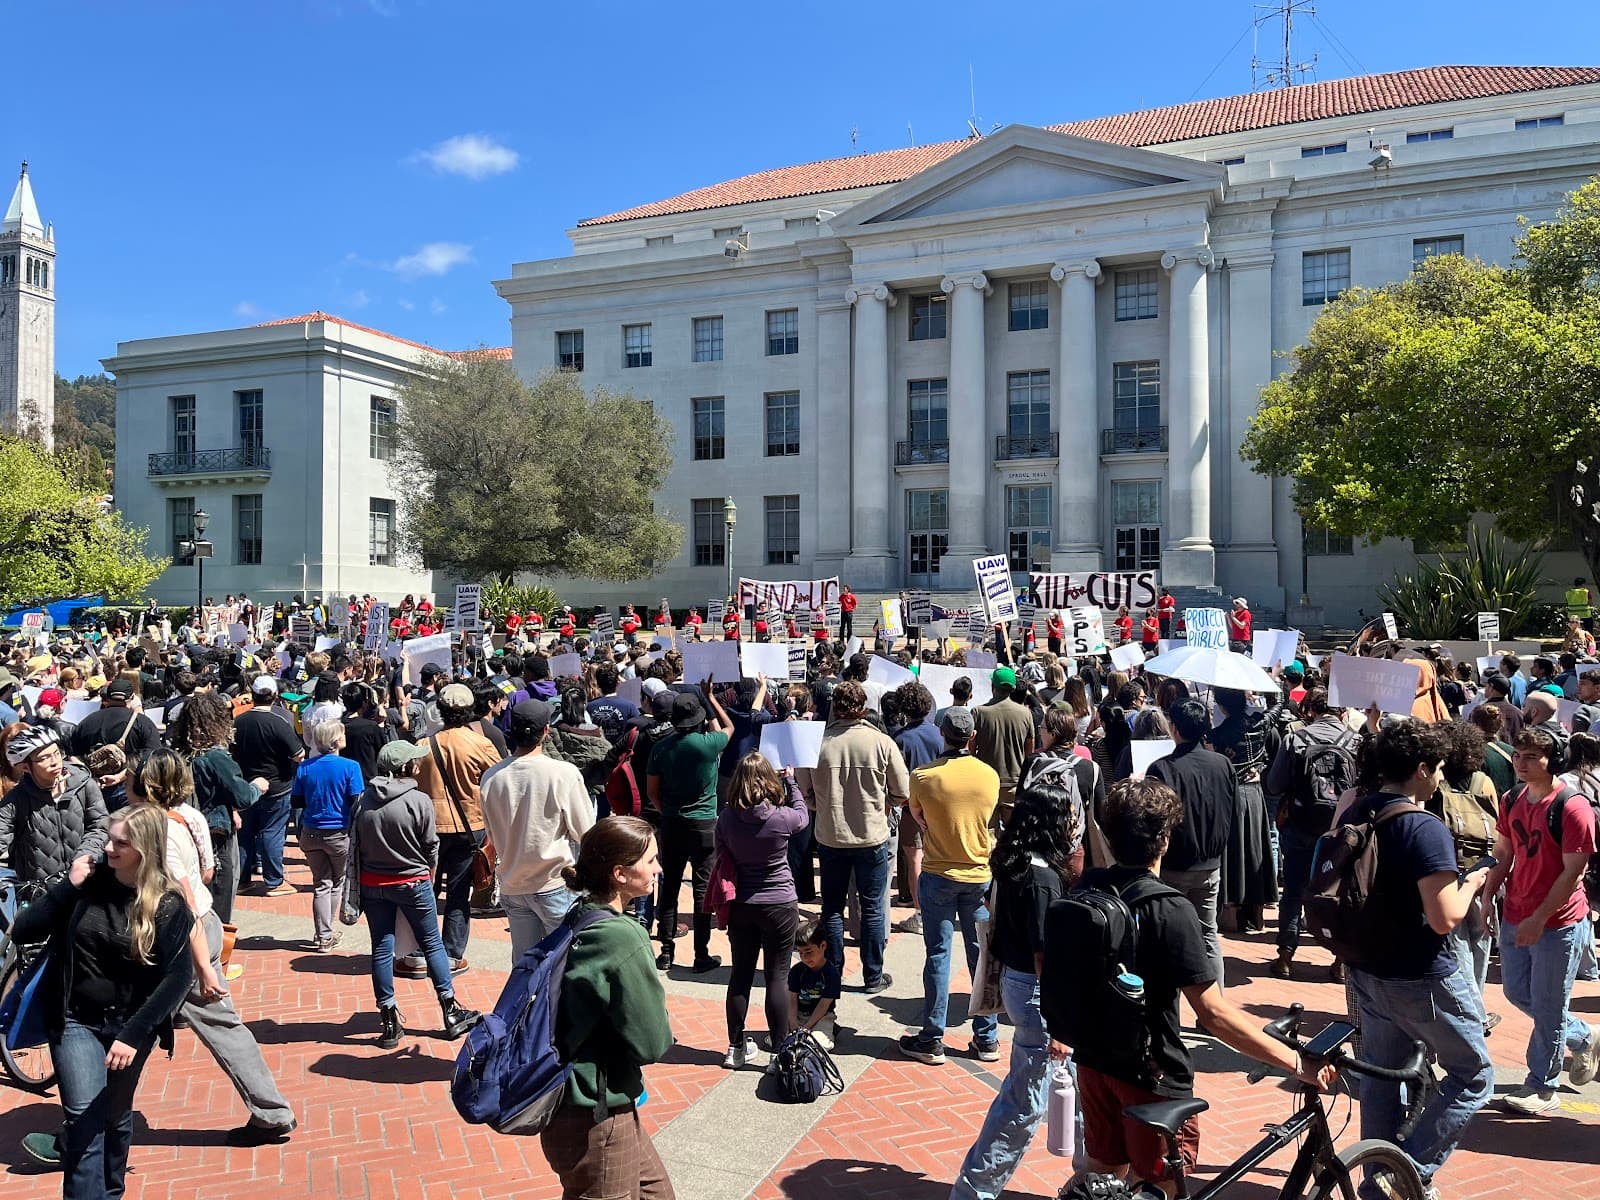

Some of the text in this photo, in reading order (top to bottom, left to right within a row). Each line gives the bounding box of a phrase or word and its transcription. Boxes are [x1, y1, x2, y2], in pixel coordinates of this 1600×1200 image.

[977, 558, 1005, 571] UAW
[740, 581, 798, 611] FUND
[809, 580, 838, 612] UC
[987, 582, 1007, 597] UNION
[1029, 575, 1072, 609] KILL
[1087, 573, 1156, 611] CUTS
[1186, 609, 1224, 631] PROTECT
[1188, 630, 1226, 648] PUBLIC
